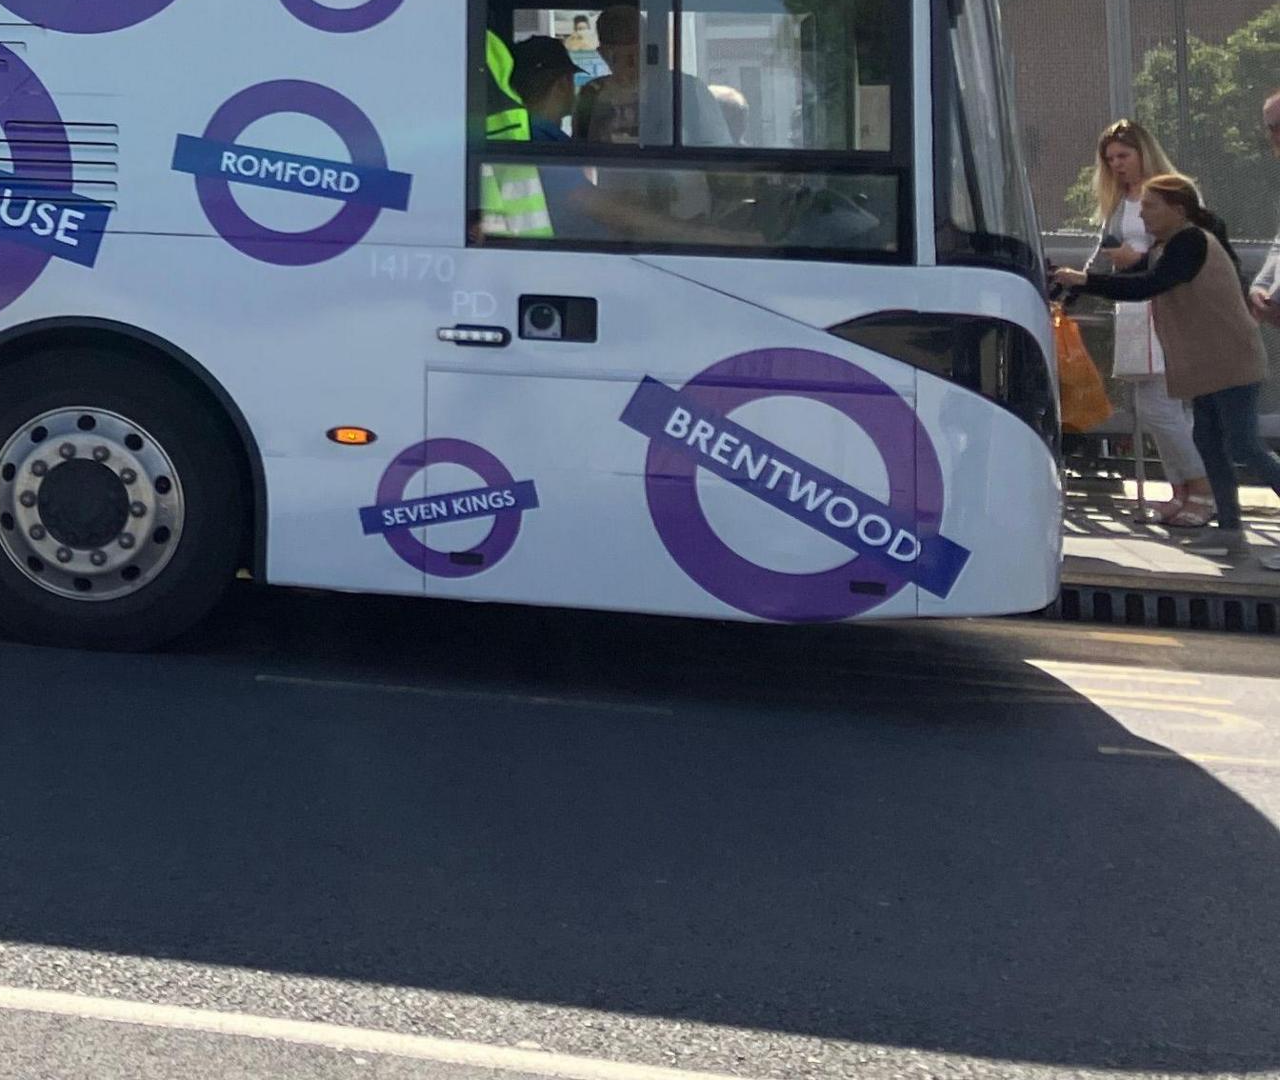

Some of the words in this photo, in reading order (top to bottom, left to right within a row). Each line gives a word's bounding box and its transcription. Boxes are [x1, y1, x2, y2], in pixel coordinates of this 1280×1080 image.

[221, 151, 359, 194] ROMFORD
[664, 407, 920, 564] BRENTWOOD
[383, 502, 446, 527] SEVEN
[452, 490, 515, 516] KINGS
